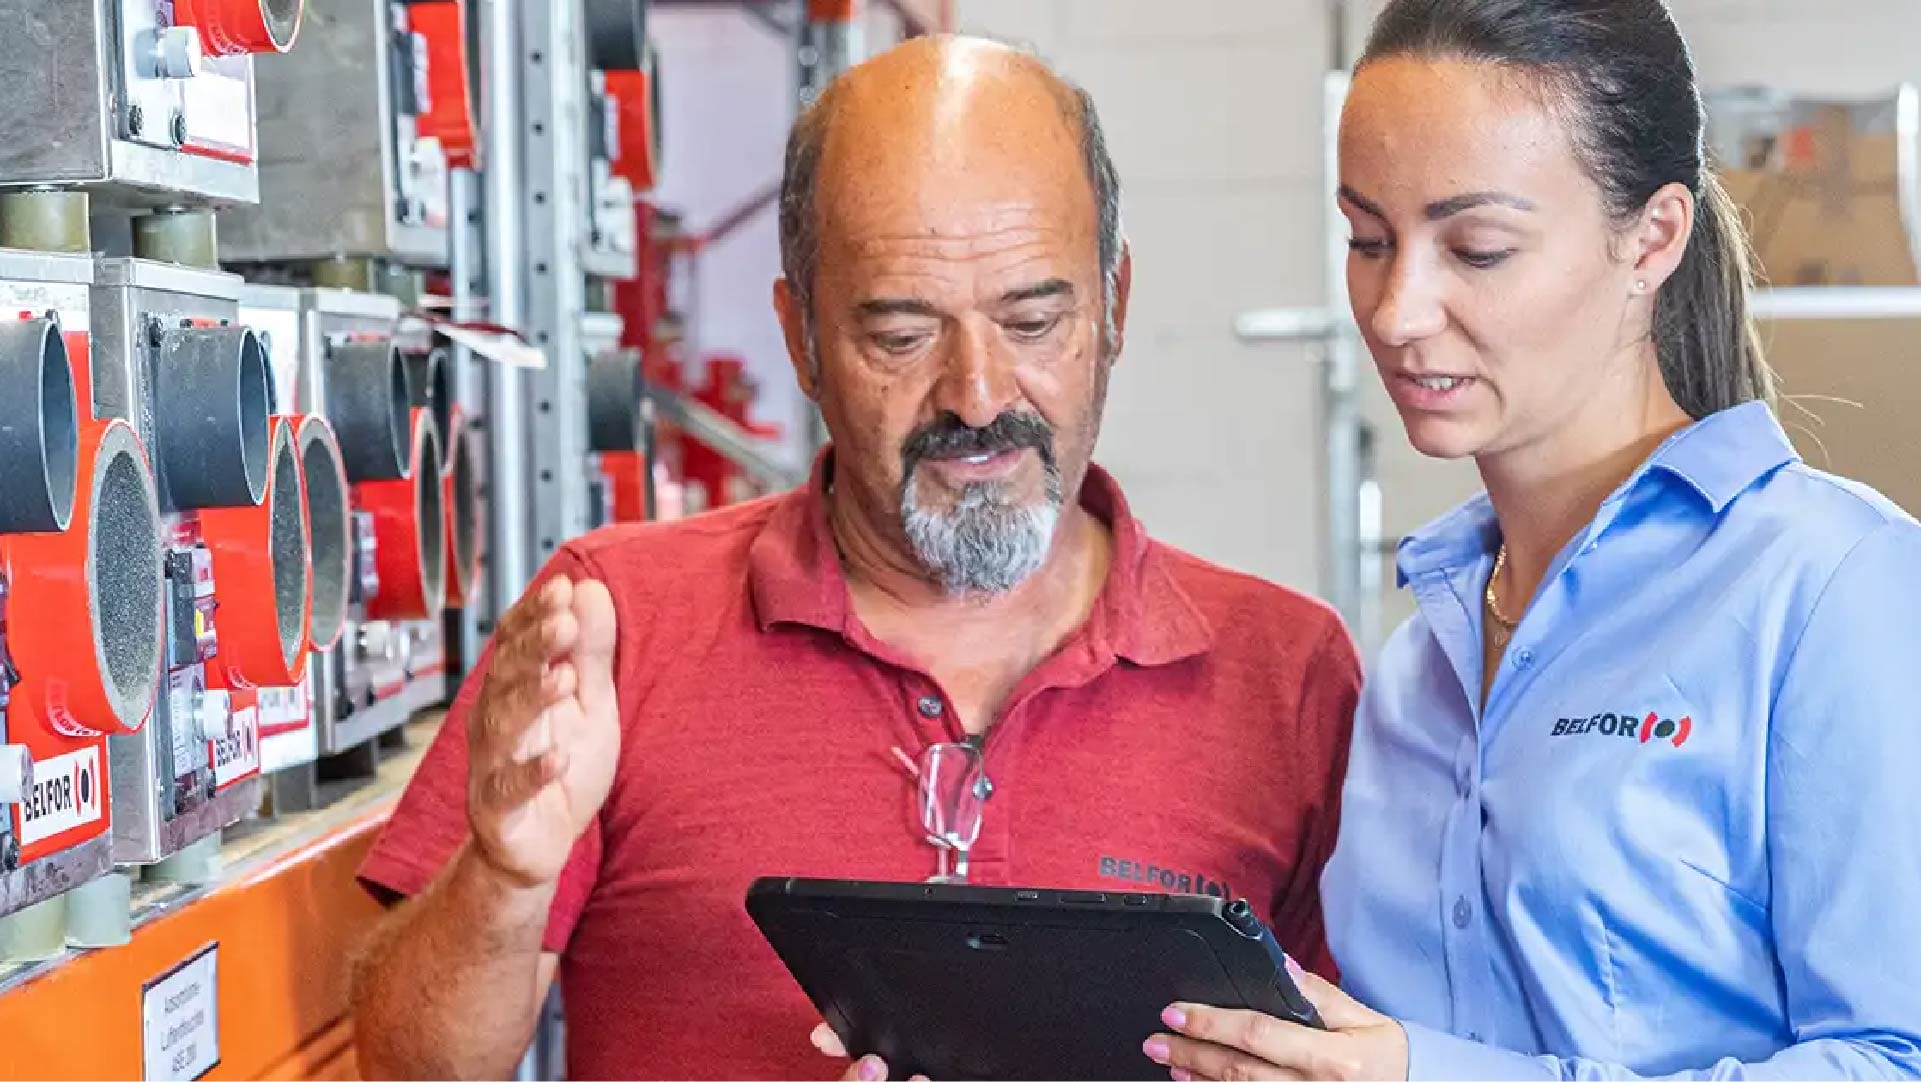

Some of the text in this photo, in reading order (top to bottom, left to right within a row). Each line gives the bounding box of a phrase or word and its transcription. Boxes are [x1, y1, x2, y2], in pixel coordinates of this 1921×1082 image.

[1550, 713, 1639, 737] BELFOR
[25, 774, 72, 822] BELFOR
[1100, 857, 1191, 893] BELFOR
